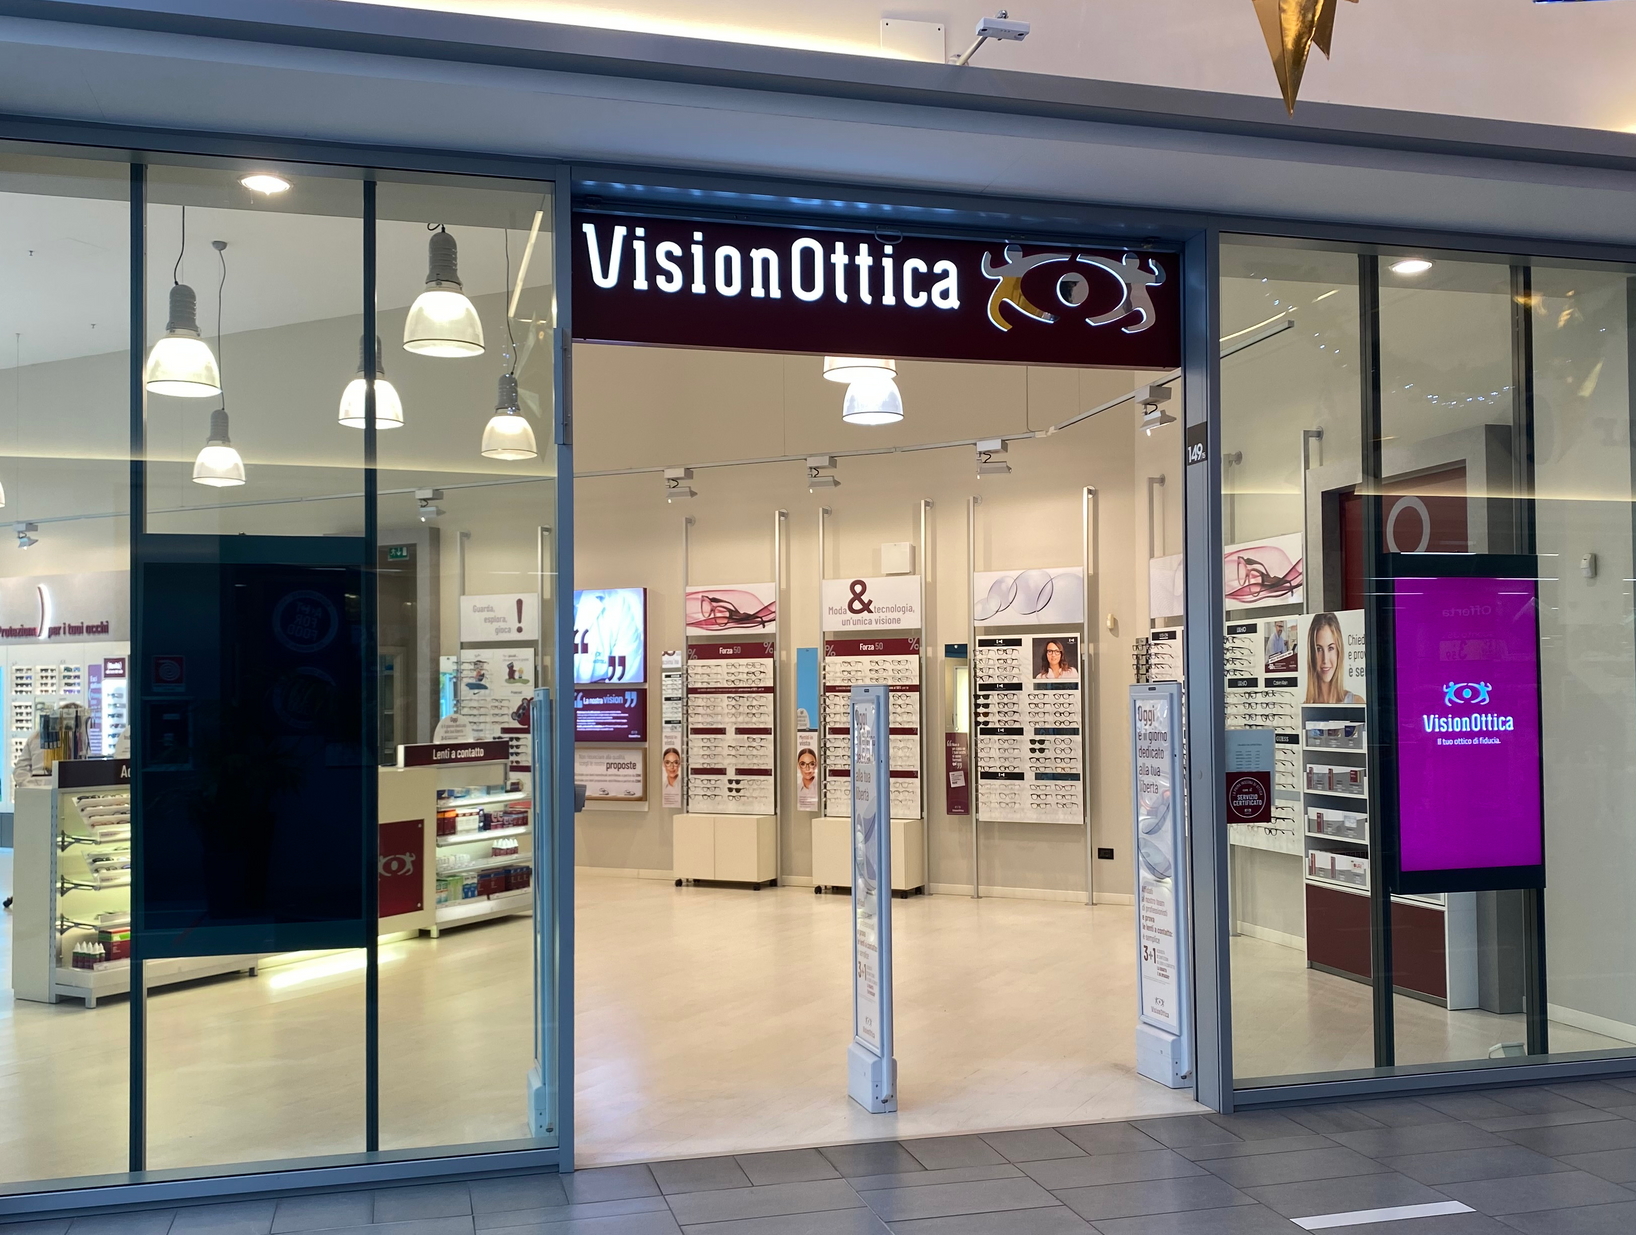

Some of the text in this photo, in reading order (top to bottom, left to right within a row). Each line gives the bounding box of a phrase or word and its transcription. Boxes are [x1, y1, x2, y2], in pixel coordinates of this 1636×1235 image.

[582, 222, 961, 311] VisionOttica
[828, 579, 915, 615] Moda & tecnologia,
[472, 604, 495, 613] Guarda,
[86, 620, 109, 634] occhi
[842, 616, 901, 626] un'unica visione
[495, 625, 511, 635] gioca
[1349, 664, 1353, 677] è
[603, 694, 623, 704] vision
[1138, 705, 1155, 726] Oggi
[1422, 713, 1514, 732] VisionOttica
[1148, 728, 1167, 744] giorno
[432, 747, 484, 760] Lenti a contatto
[1138, 745, 1164, 759] dedicato
[606, 761, 637, 771] proposte
[1139, 763, 1160, 776] alla tua
[1143, 944, 1156, 964] 3+1
